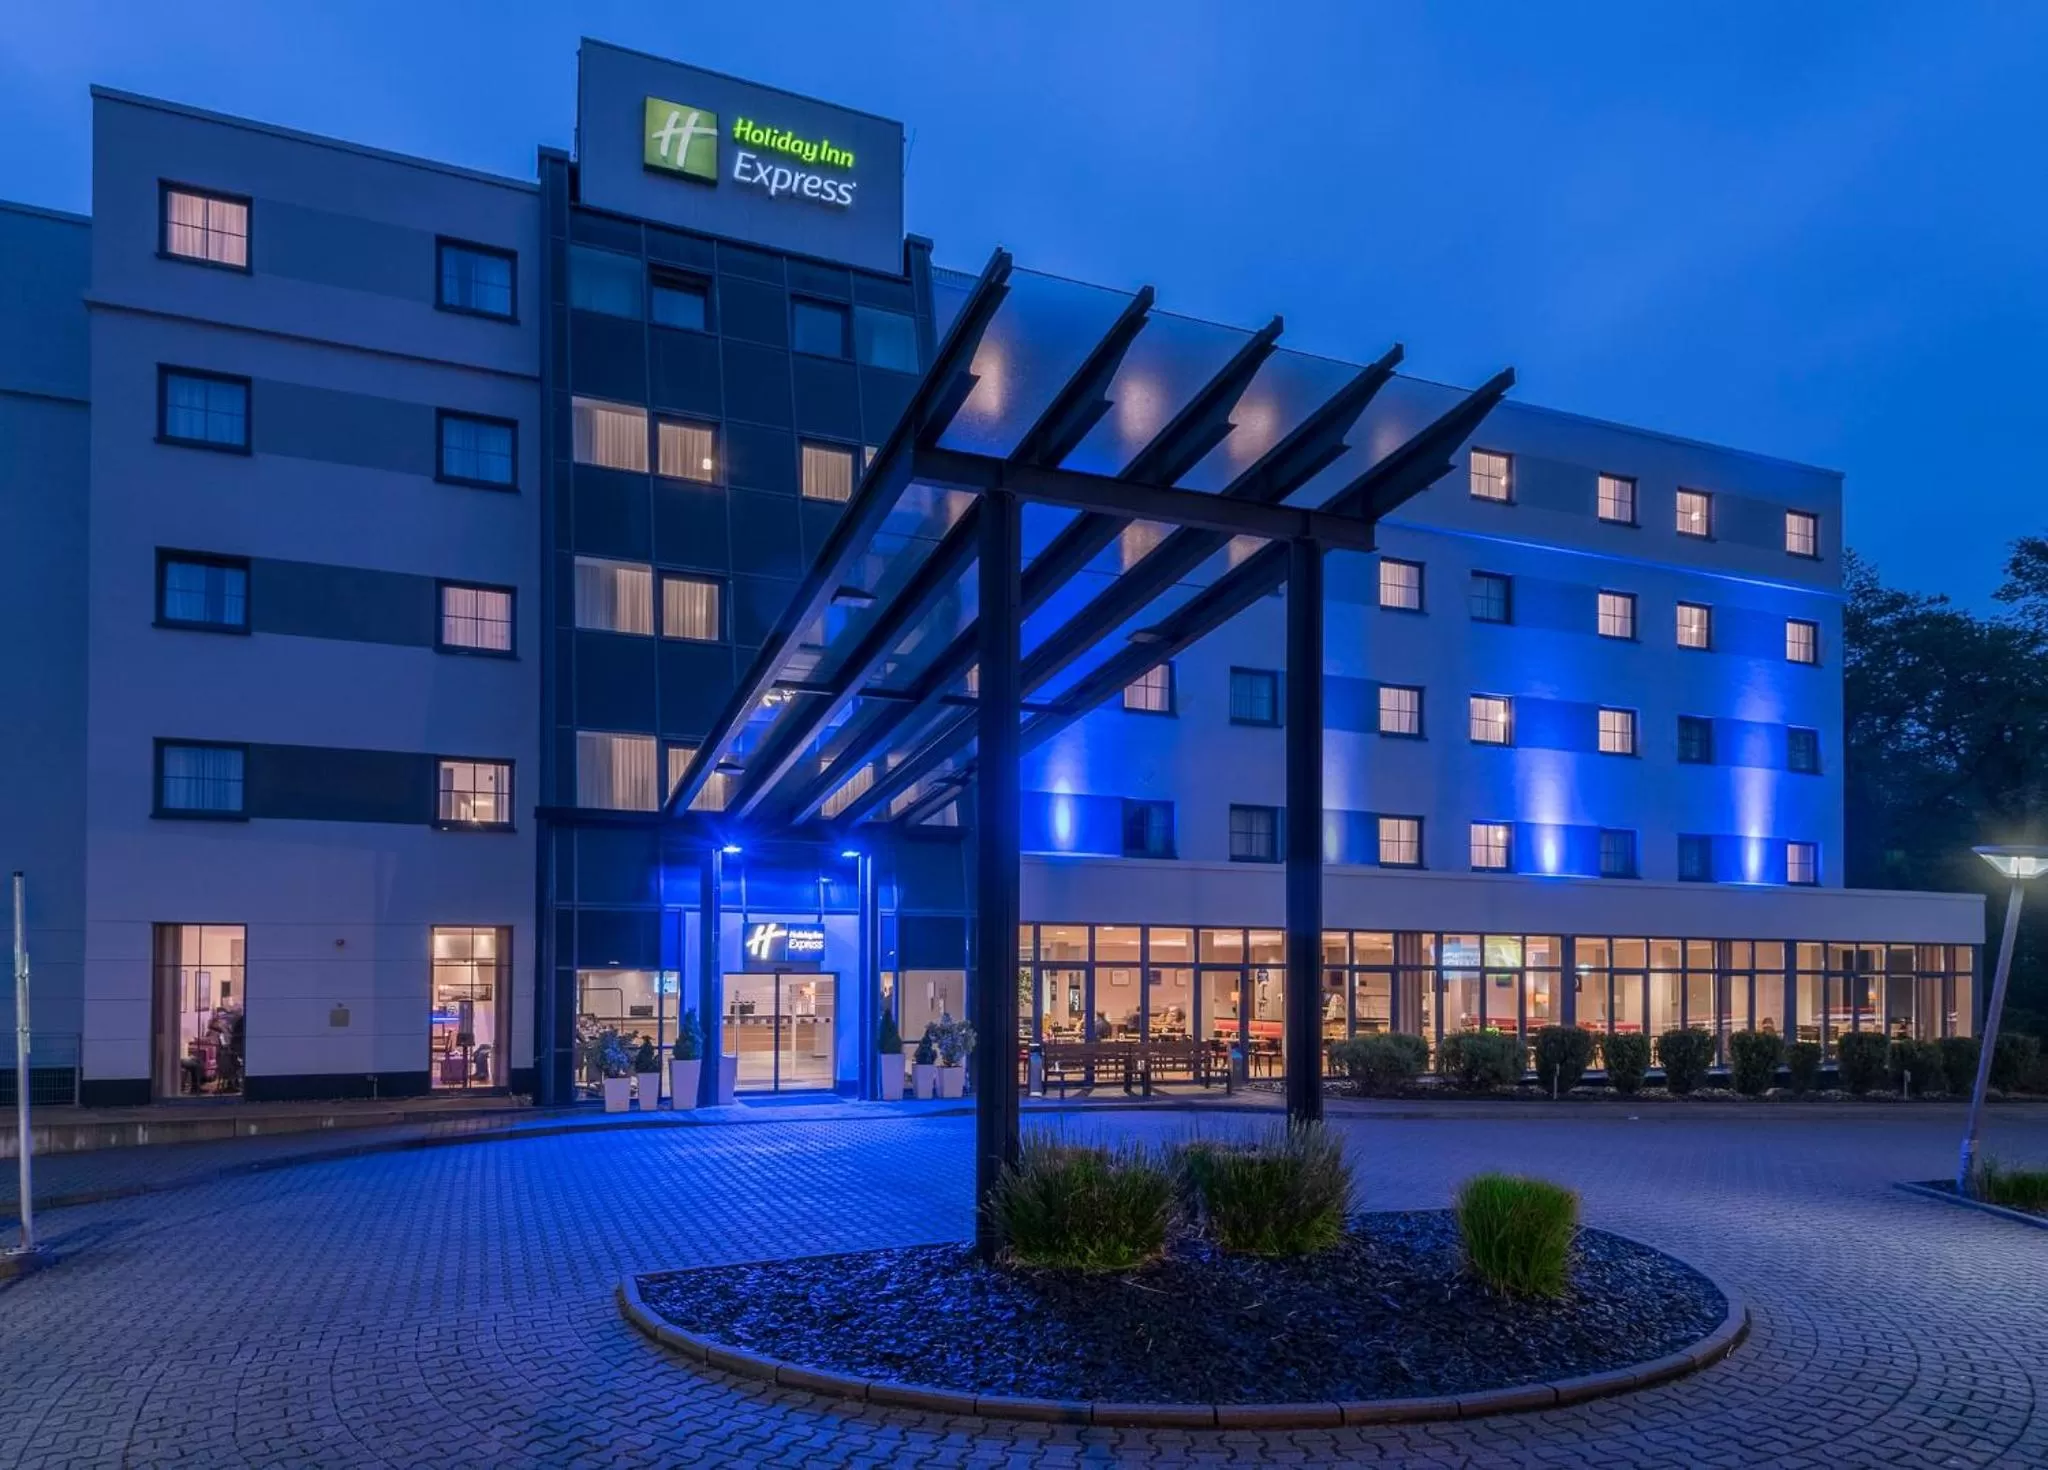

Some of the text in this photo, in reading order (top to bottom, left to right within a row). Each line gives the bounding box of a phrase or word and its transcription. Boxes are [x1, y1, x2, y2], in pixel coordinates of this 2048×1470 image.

[733, 117, 854, 168] Holiday Inn
[733, 152, 853, 205] Express
